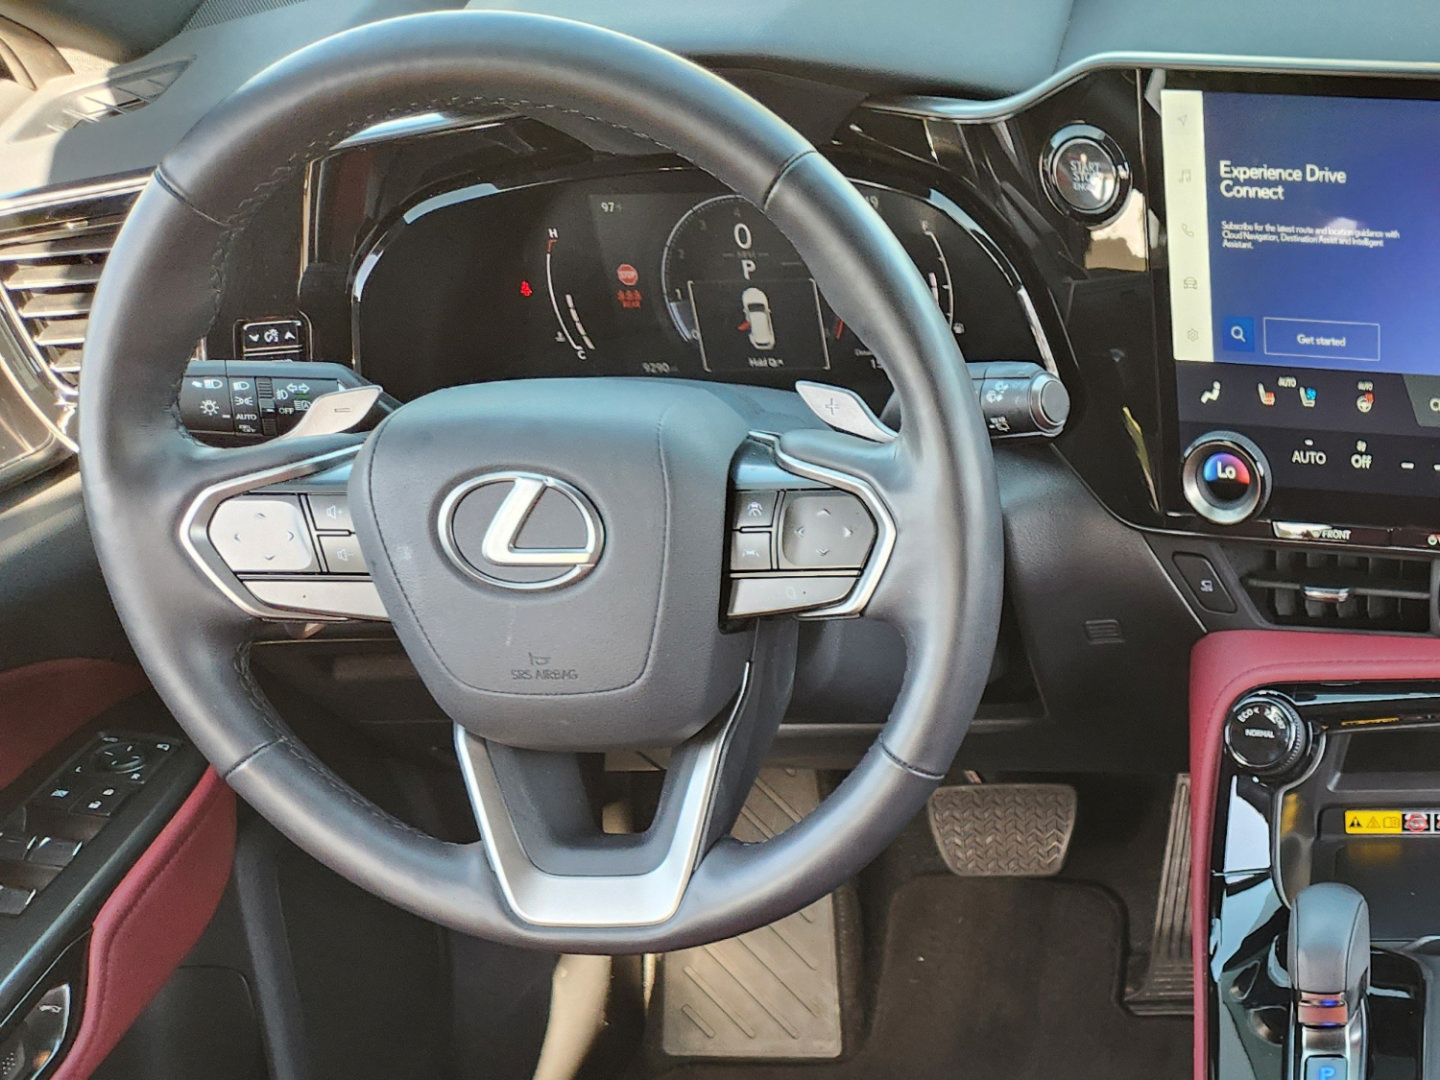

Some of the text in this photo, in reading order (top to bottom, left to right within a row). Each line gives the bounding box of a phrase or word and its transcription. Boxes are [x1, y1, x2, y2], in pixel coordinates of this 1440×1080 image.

[1219, 160, 1347, 184] Experience Drive
[1220, 180, 1285, 200] Connect
[548, 228, 558, 238] H
[1254, 222, 1264, 232] for
[1264, 223, 1276, 232] the
[1384, 229, 1400, 239] with
[741, 259, 756, 280] P
[1296, 334, 1347, 347] Get started
[279, 406, 294, 415] OFF
[1292, 450, 1327, 465] AUTO
[1351, 454, 1372, 469] Off
[1216, 461, 1236, 479] Lo
[1321, 528, 1351, 540] FRONT
[535, 669, 578, 680] AIRBAG
[1237, 708, 1253, 723] ECO
[1245, 728, 1275, 739] NORMAL
